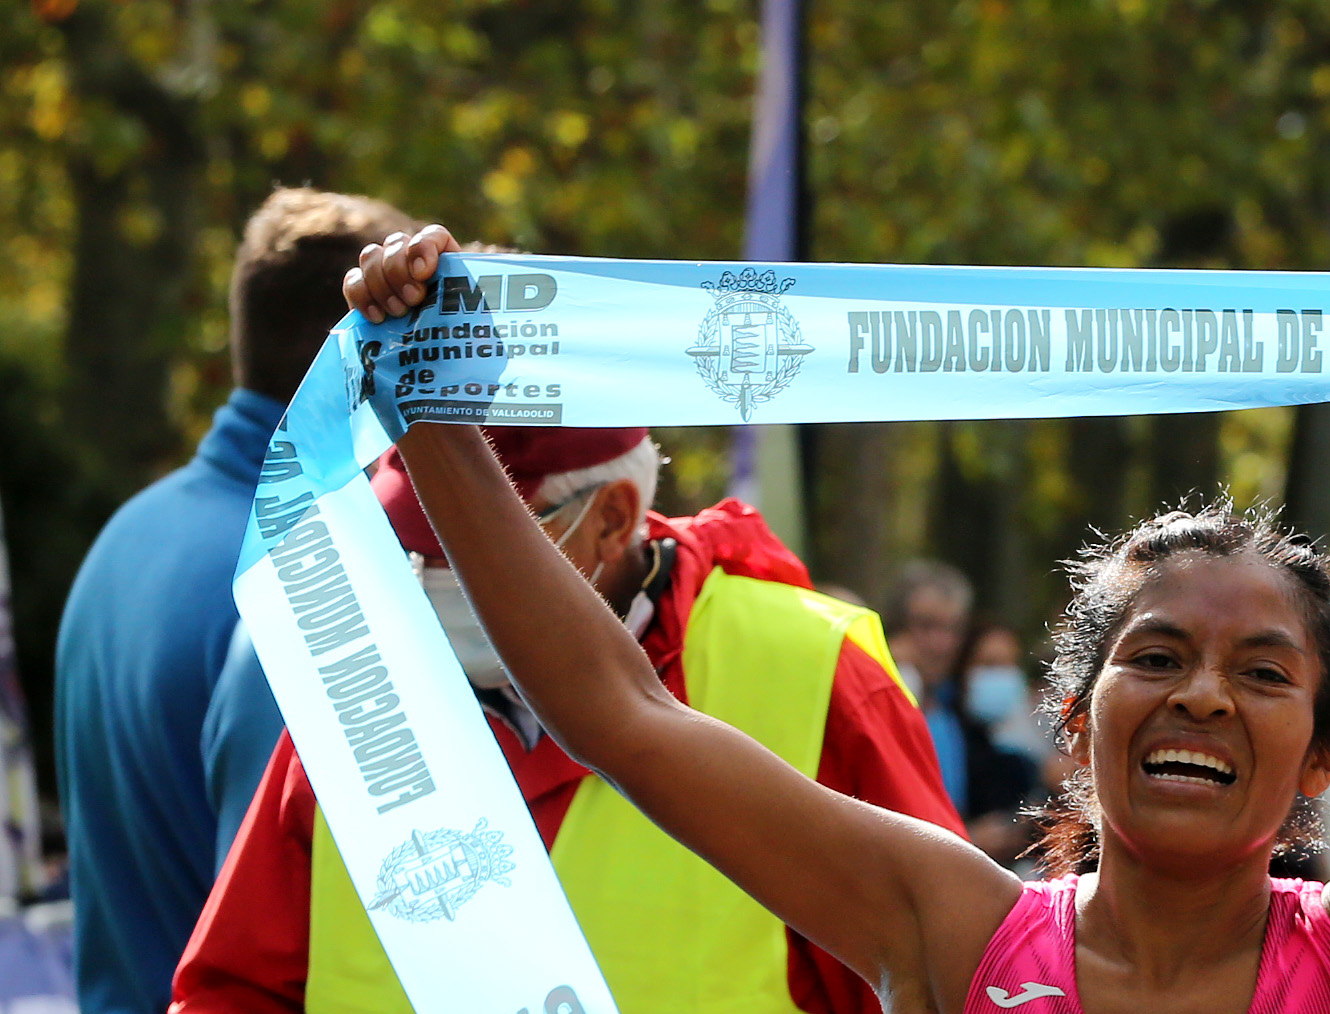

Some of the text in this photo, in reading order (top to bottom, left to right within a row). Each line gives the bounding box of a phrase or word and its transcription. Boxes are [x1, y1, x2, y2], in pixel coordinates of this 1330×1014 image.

[402, 320, 558, 345] Fundación
[847, 309, 1050, 374] FUNDACION
[1065, 308, 1264, 374] MUNICIPAL
[1276, 310, 1322, 374] DE
[398, 341, 560, 367] Municipal
[400, 368, 435, 386] de
[475, 408, 490, 417] DE
[492, 409, 554, 418] VALLADOLID
